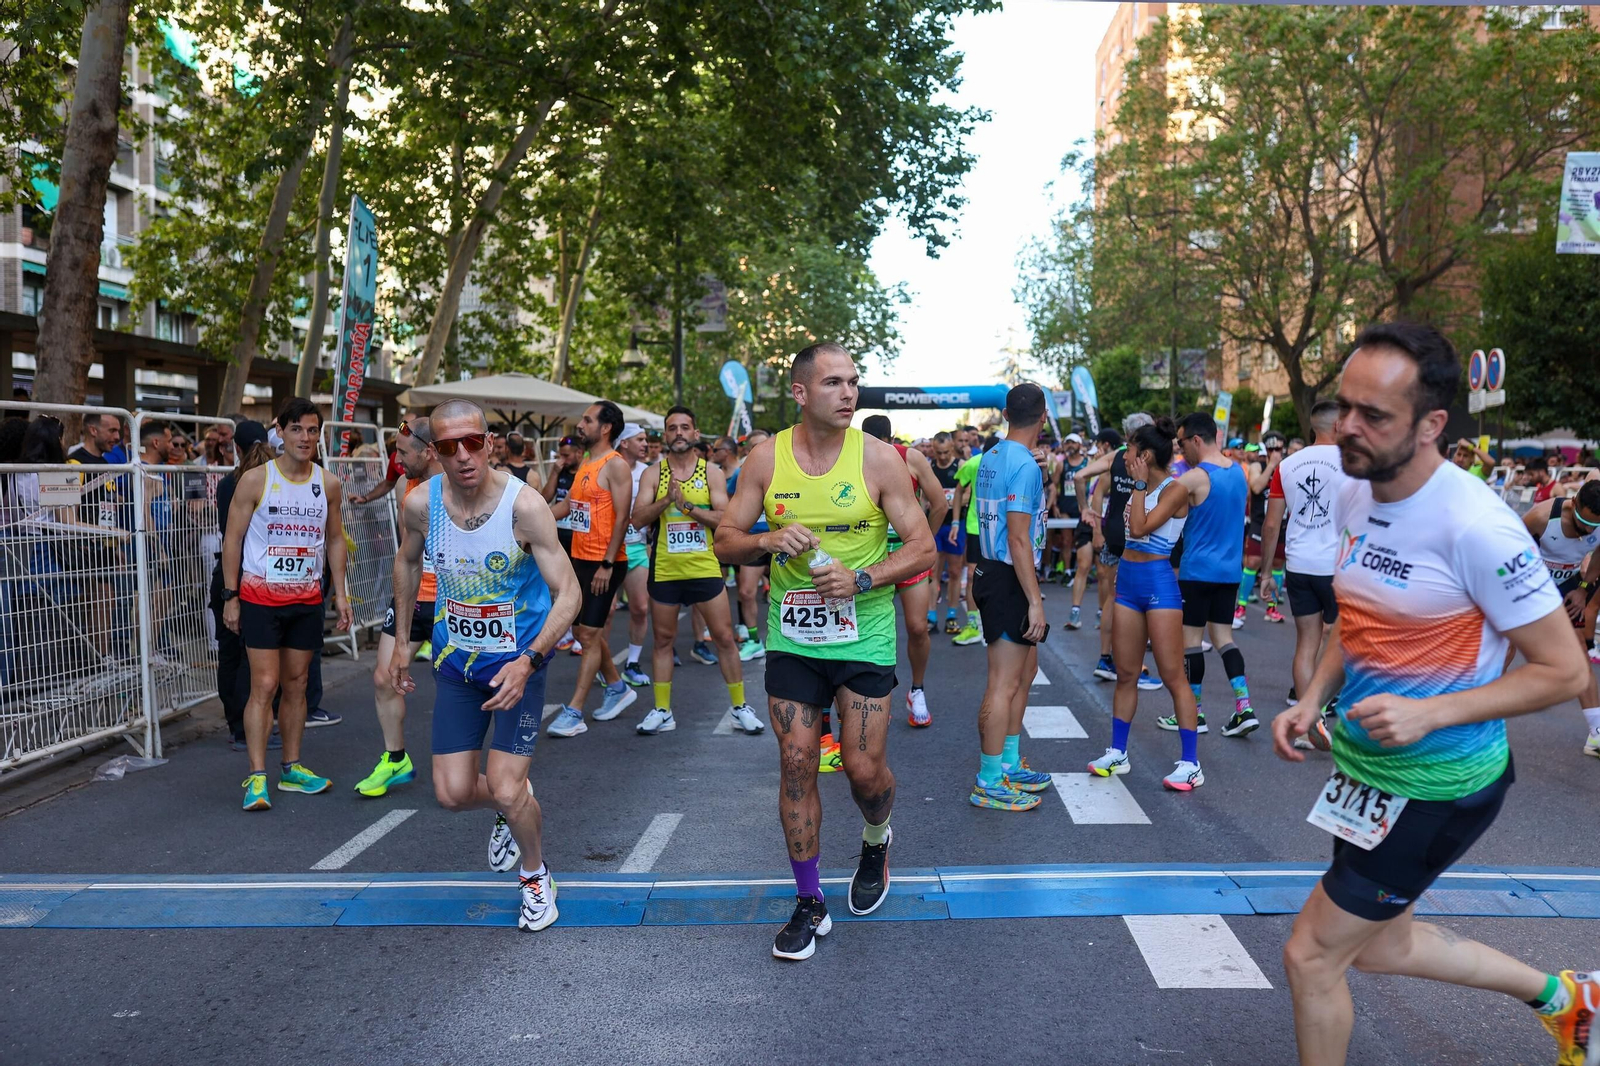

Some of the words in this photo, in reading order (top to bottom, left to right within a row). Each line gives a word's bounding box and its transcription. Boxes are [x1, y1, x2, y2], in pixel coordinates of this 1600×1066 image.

[363, 254, 371, 288] 1
[884, 392, 971, 404] POWERADE
[267, 523, 321, 533] GRANADA
[268, 530, 320, 539] RUNNERS
[669, 531, 701, 544] 3096
[273, 557, 305, 572] 497
[1361, 551, 1413, 580] CORRE
[448, 601, 456, 614] 41
[783, 607, 840, 628] 4251
[448, 615, 502, 639] 5690
[851, 701, 883, 712] JUANA
